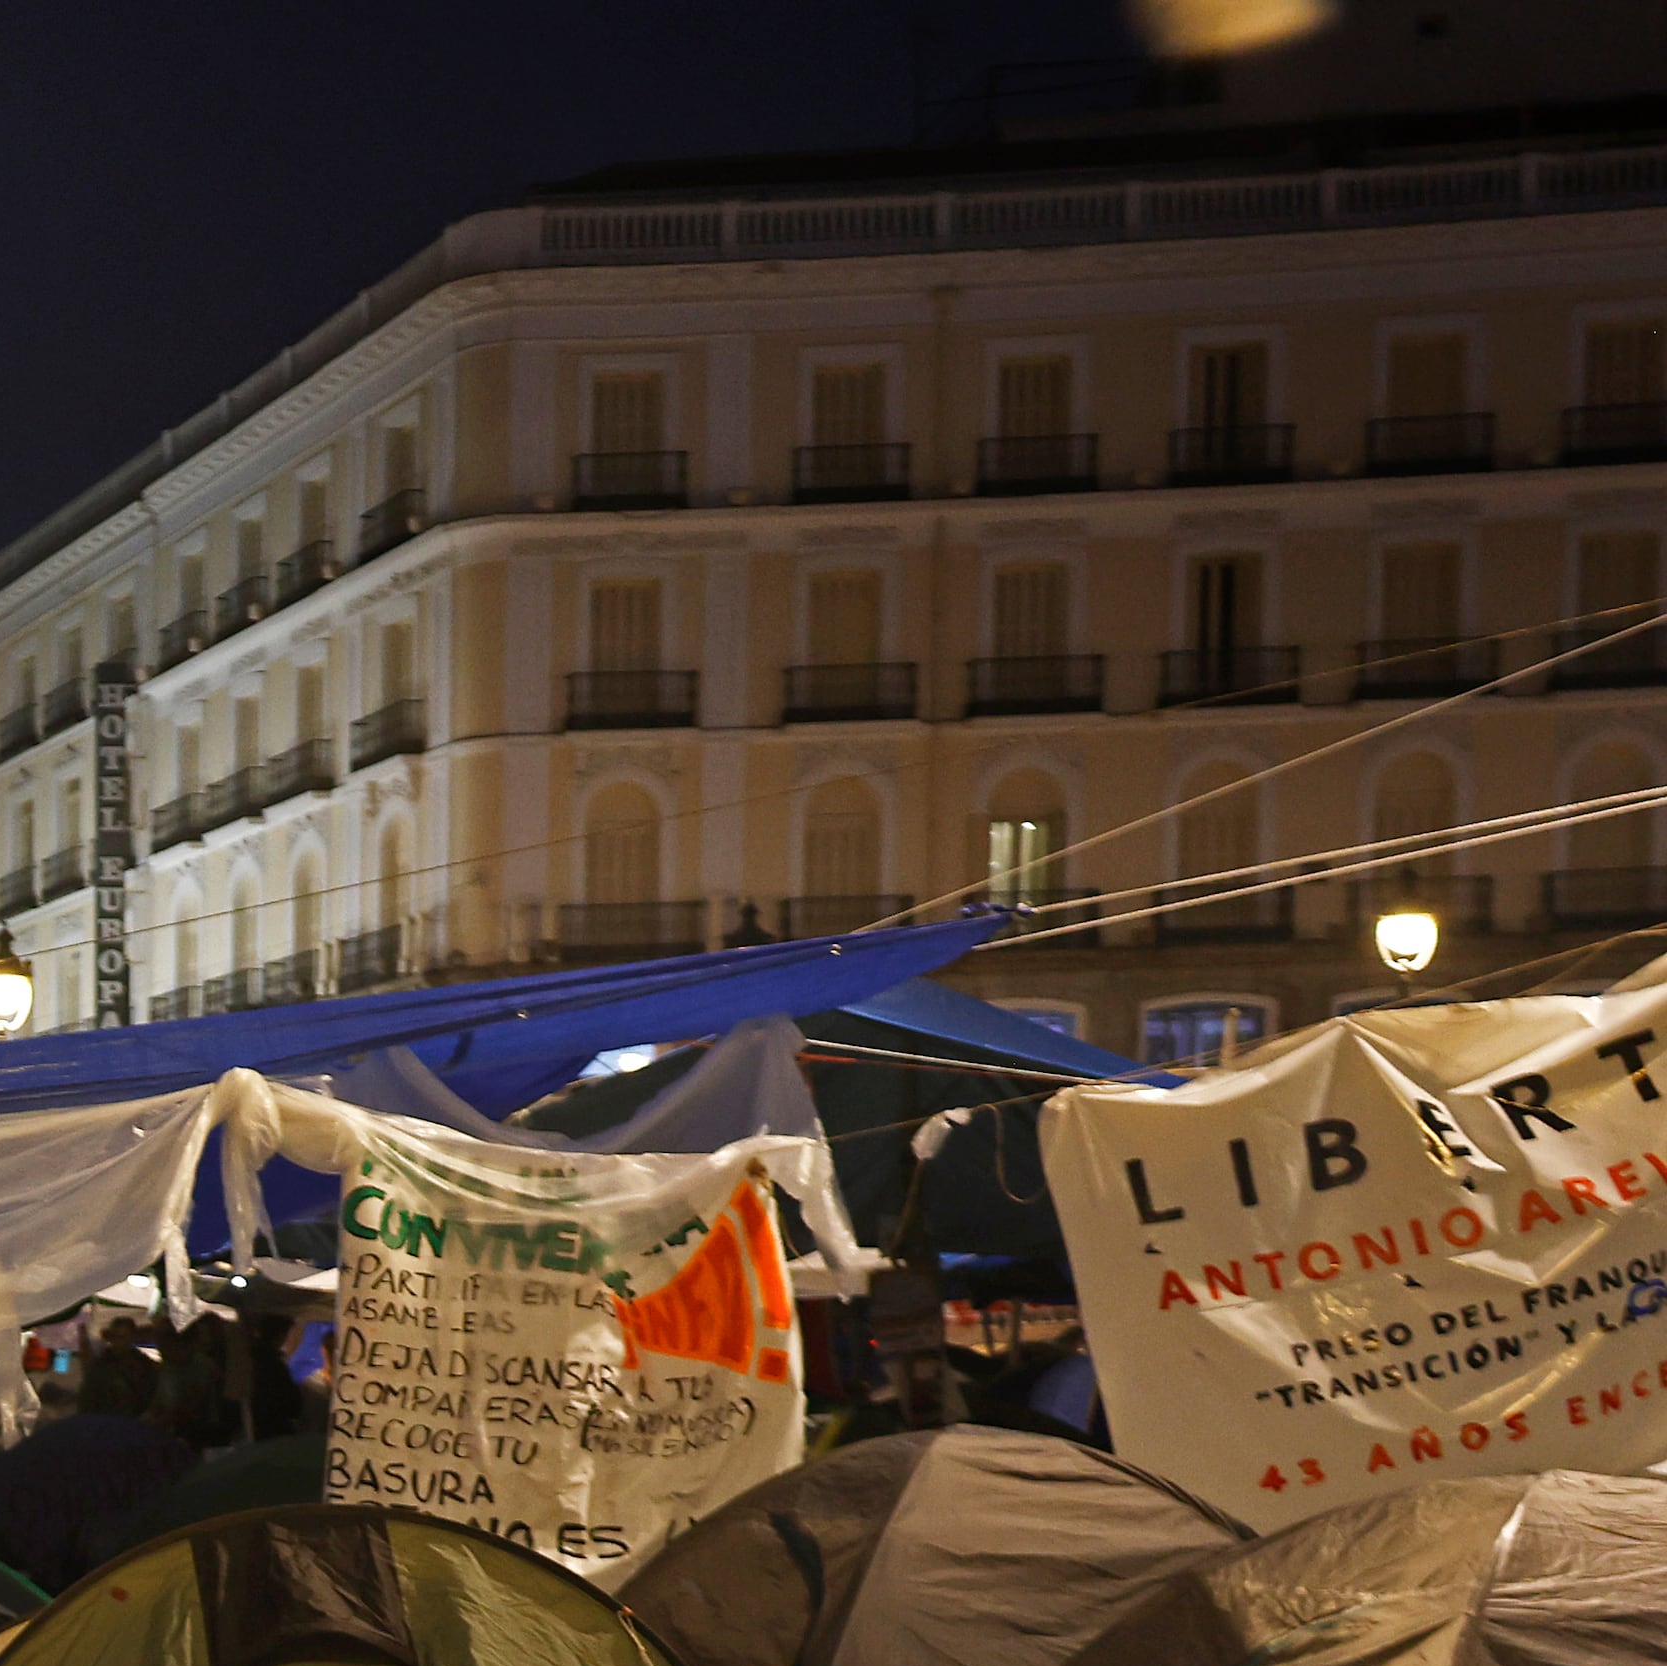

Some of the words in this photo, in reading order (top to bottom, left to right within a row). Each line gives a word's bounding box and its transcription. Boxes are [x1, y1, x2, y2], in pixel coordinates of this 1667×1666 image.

[98, 683, 126, 832] HOTEL
[97, 854, 126, 1030] EUROPA
[1159, 1206, 1484, 1312] ANTONIO
[339, 1325, 438, 1377] DEJA
[449, 1349, 623, 1398] DSCANSAR
[1291, 1321, 1413, 1367] PRESO
[1430, 1300, 1509, 1335] DEL
[1556, 1320, 1579, 1346] Y
[331, 1407, 472, 1458] RECOGE
[488, 1434, 539, 1465] TU
[1259, 1458, 1327, 1493] 43
[1368, 1410, 1531, 1474] AÑOS
[327, 1448, 495, 1505] BASURA
[556, 1521, 630, 1560] ES
